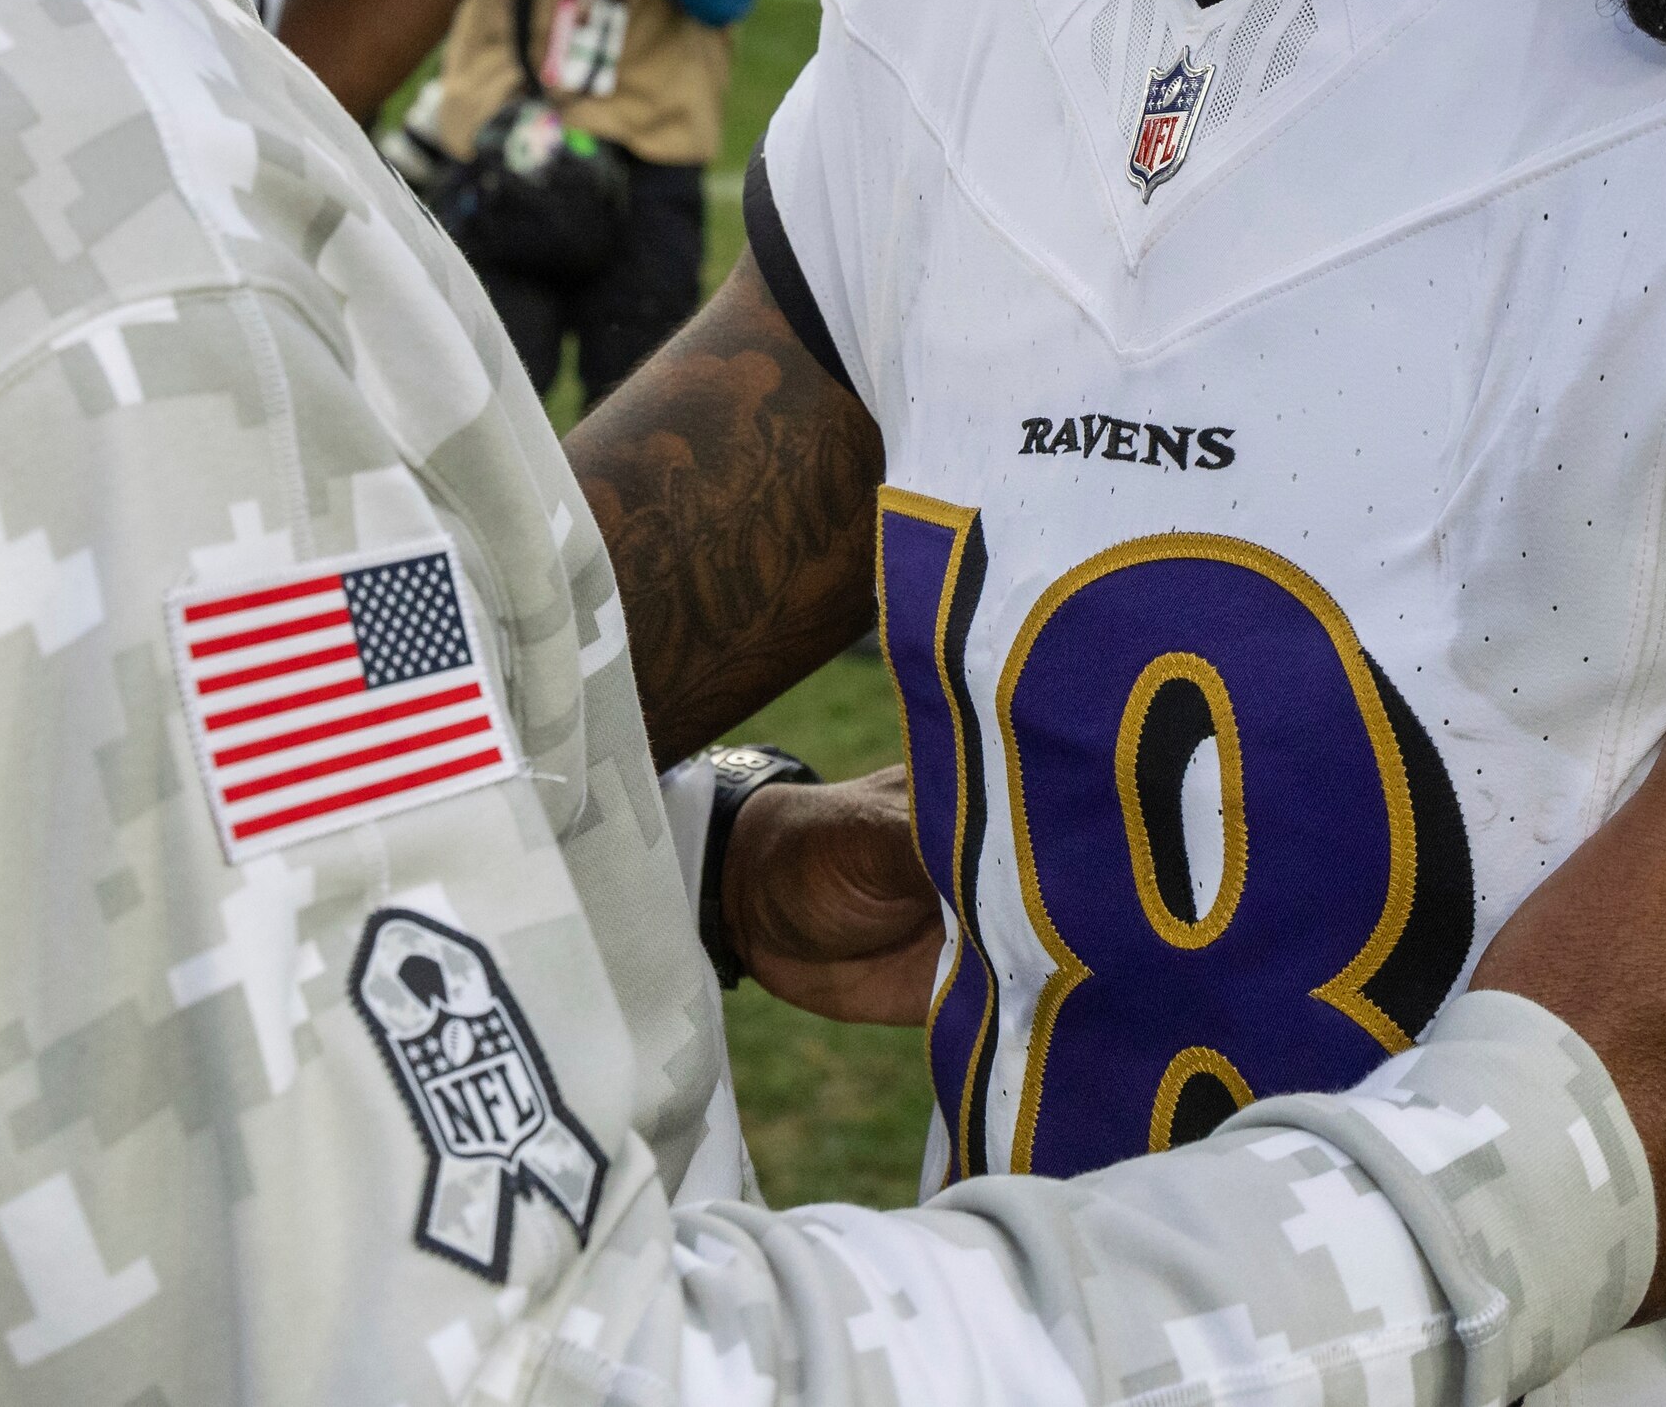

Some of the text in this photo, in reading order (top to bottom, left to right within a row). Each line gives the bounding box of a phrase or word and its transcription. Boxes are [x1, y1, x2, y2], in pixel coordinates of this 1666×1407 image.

[1134, 115, 1180, 173] NFL
[1017, 412, 1237, 472] RAVENS
[433, 1064, 536, 1144] NFL
